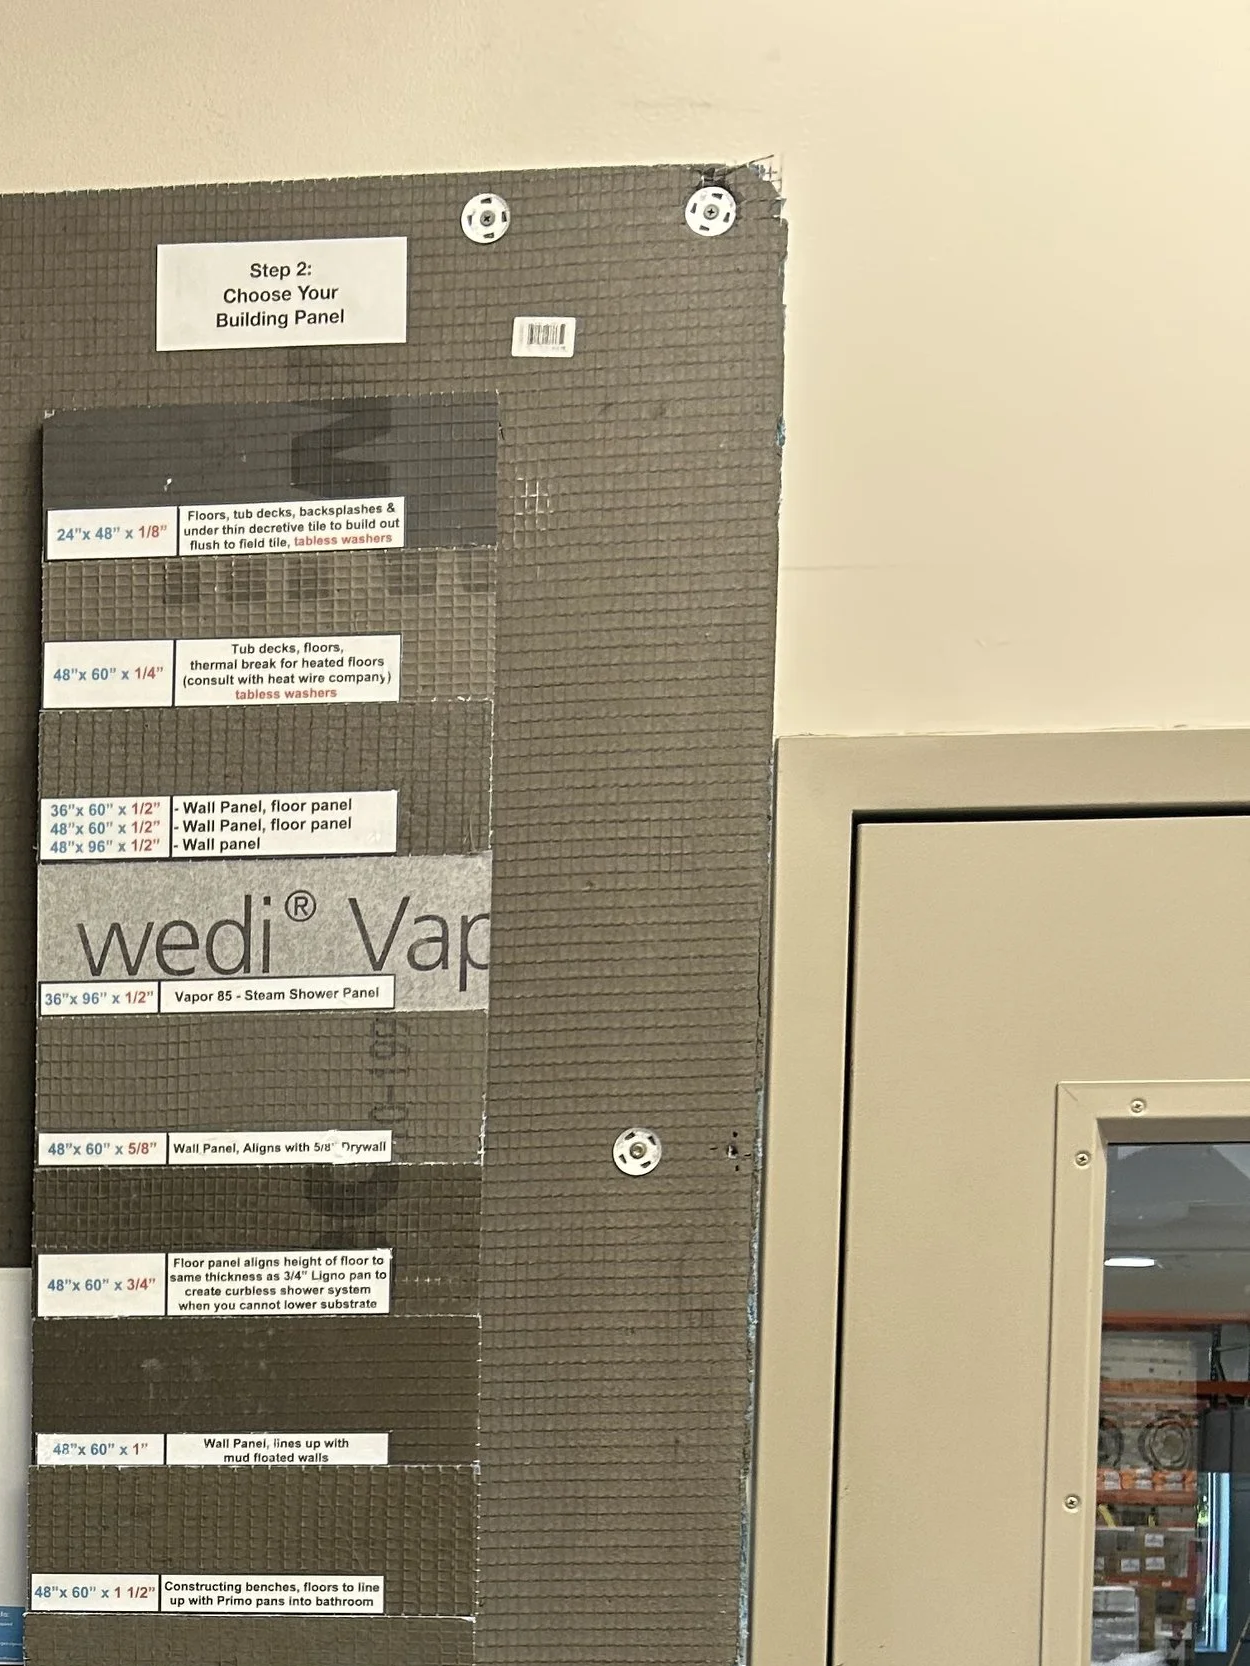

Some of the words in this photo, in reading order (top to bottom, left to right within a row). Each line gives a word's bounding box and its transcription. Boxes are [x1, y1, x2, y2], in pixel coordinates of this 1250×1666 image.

[250, 263, 291, 280] Step
[297, 262, 311, 276] 2:
[224, 288, 291, 304] Choose
[298, 286, 339, 301] Your
[217, 312, 288, 329] Building
[295, 309, 344, 325] Panel
[188, 511, 229, 521] Floors,
[234, 509, 253, 519] tub
[257, 508, 295, 519] decks,
[300, 504, 382, 518] backsplashes
[387, 502, 395, 513] &
[190, 540, 220, 551] flush
[224, 540, 236, 549] to
[239, 538, 265, 549] field
[269, 537, 290, 549] tile,
[294, 536, 338, 546] tabless
[342, 534, 392, 544] washers
[232, 644, 255, 654] Tub
[259, 643, 300, 655] decks,
[304, 642, 343, 654] floors,
[190, 659, 237, 670] thermal
[242, 658, 276, 669] break
[280, 658, 298, 669] for
[302, 657, 344, 668] heated
[348, 657, 384, 667] floors
[175, 991, 214, 1004] Vapor
[218, 990, 232, 1001] 85
[245, 990, 285, 1001] Steam
[290, 989, 339, 1000] Shower
[343, 987, 379, 998] Panel
[185, 1287, 222, 1296] create
[226, 1286, 276, 1296] curbless
[280, 1286, 325, 1295] shower
[328, 1285, 371, 1297] system
